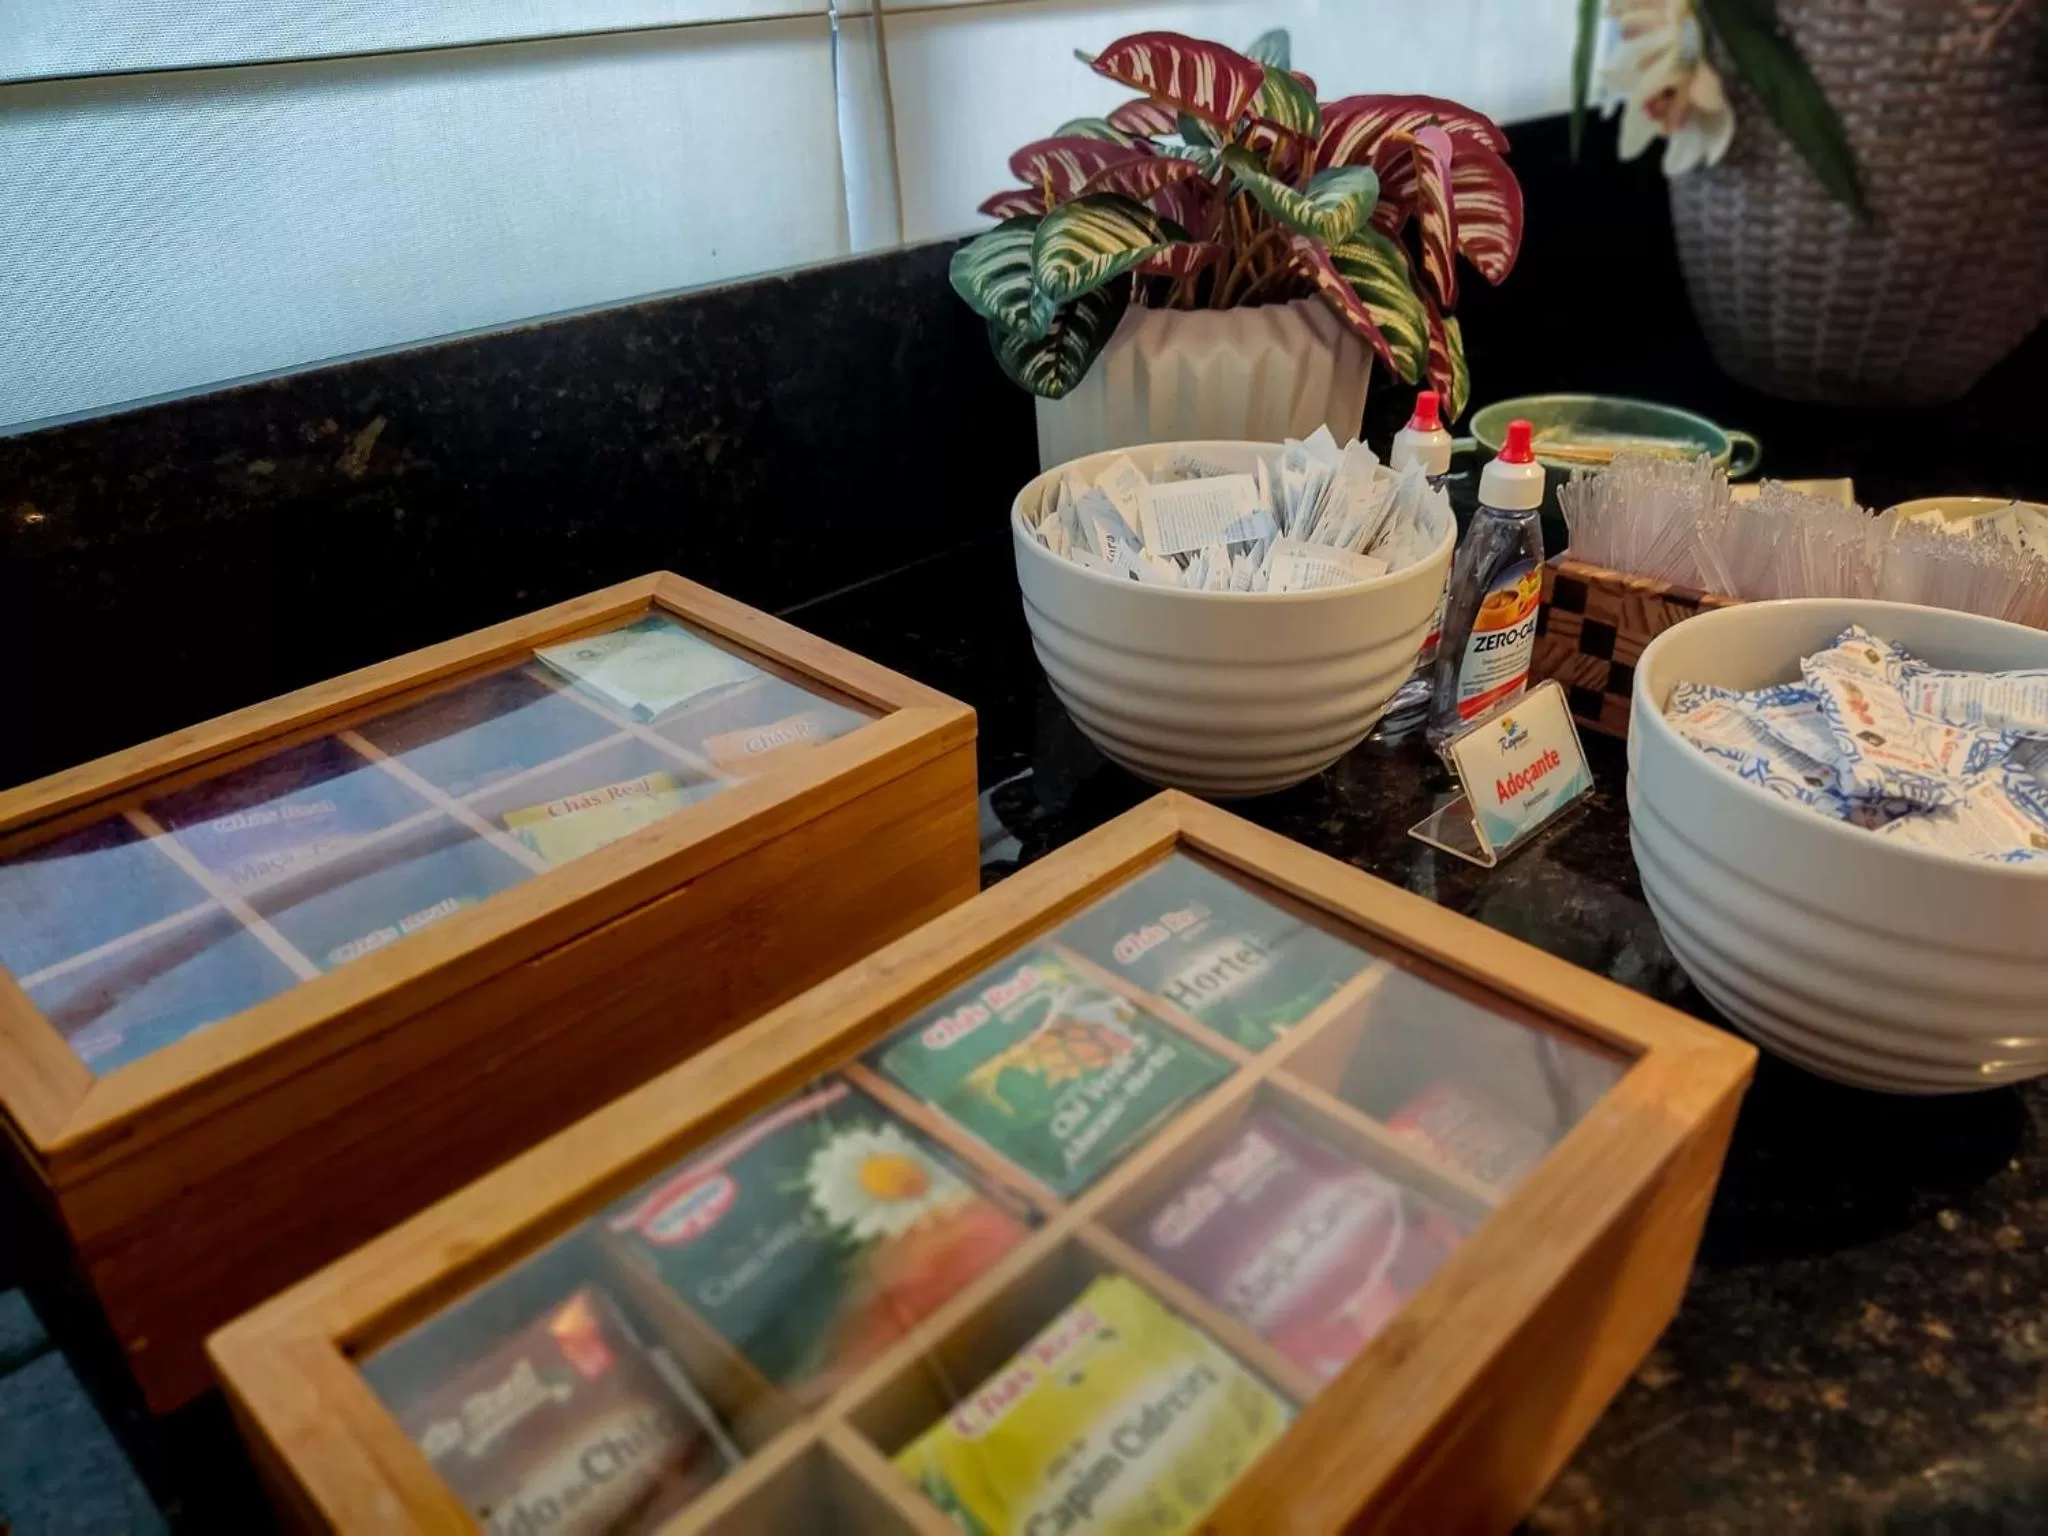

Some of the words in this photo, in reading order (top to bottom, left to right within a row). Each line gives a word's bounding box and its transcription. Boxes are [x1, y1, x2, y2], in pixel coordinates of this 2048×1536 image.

[547, 789, 602, 818] Chás
[607, 777, 651, 803] Real
[1494, 748, 1561, 804] Adoçante
